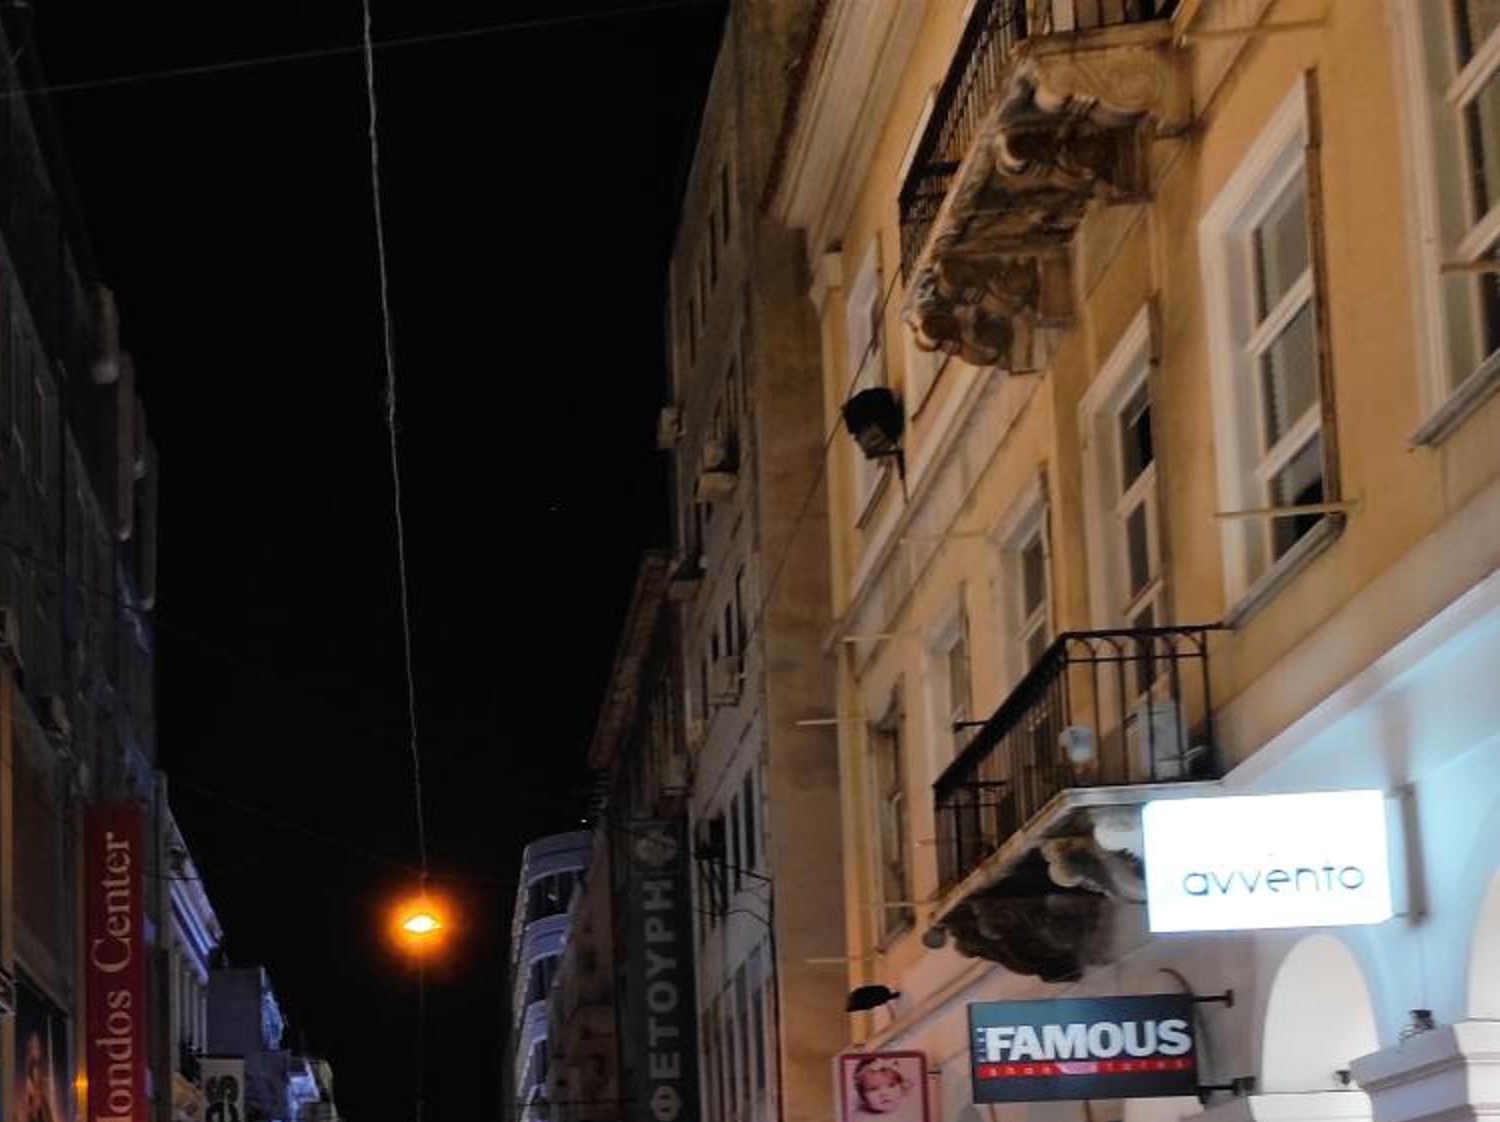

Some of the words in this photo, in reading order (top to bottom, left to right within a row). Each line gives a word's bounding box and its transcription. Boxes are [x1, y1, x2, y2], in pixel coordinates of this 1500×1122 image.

[92, 831, 133, 973] Center
[1182, 865, 1365, 897] avvento
[986, 1019, 1192, 1062] FAMOUS
